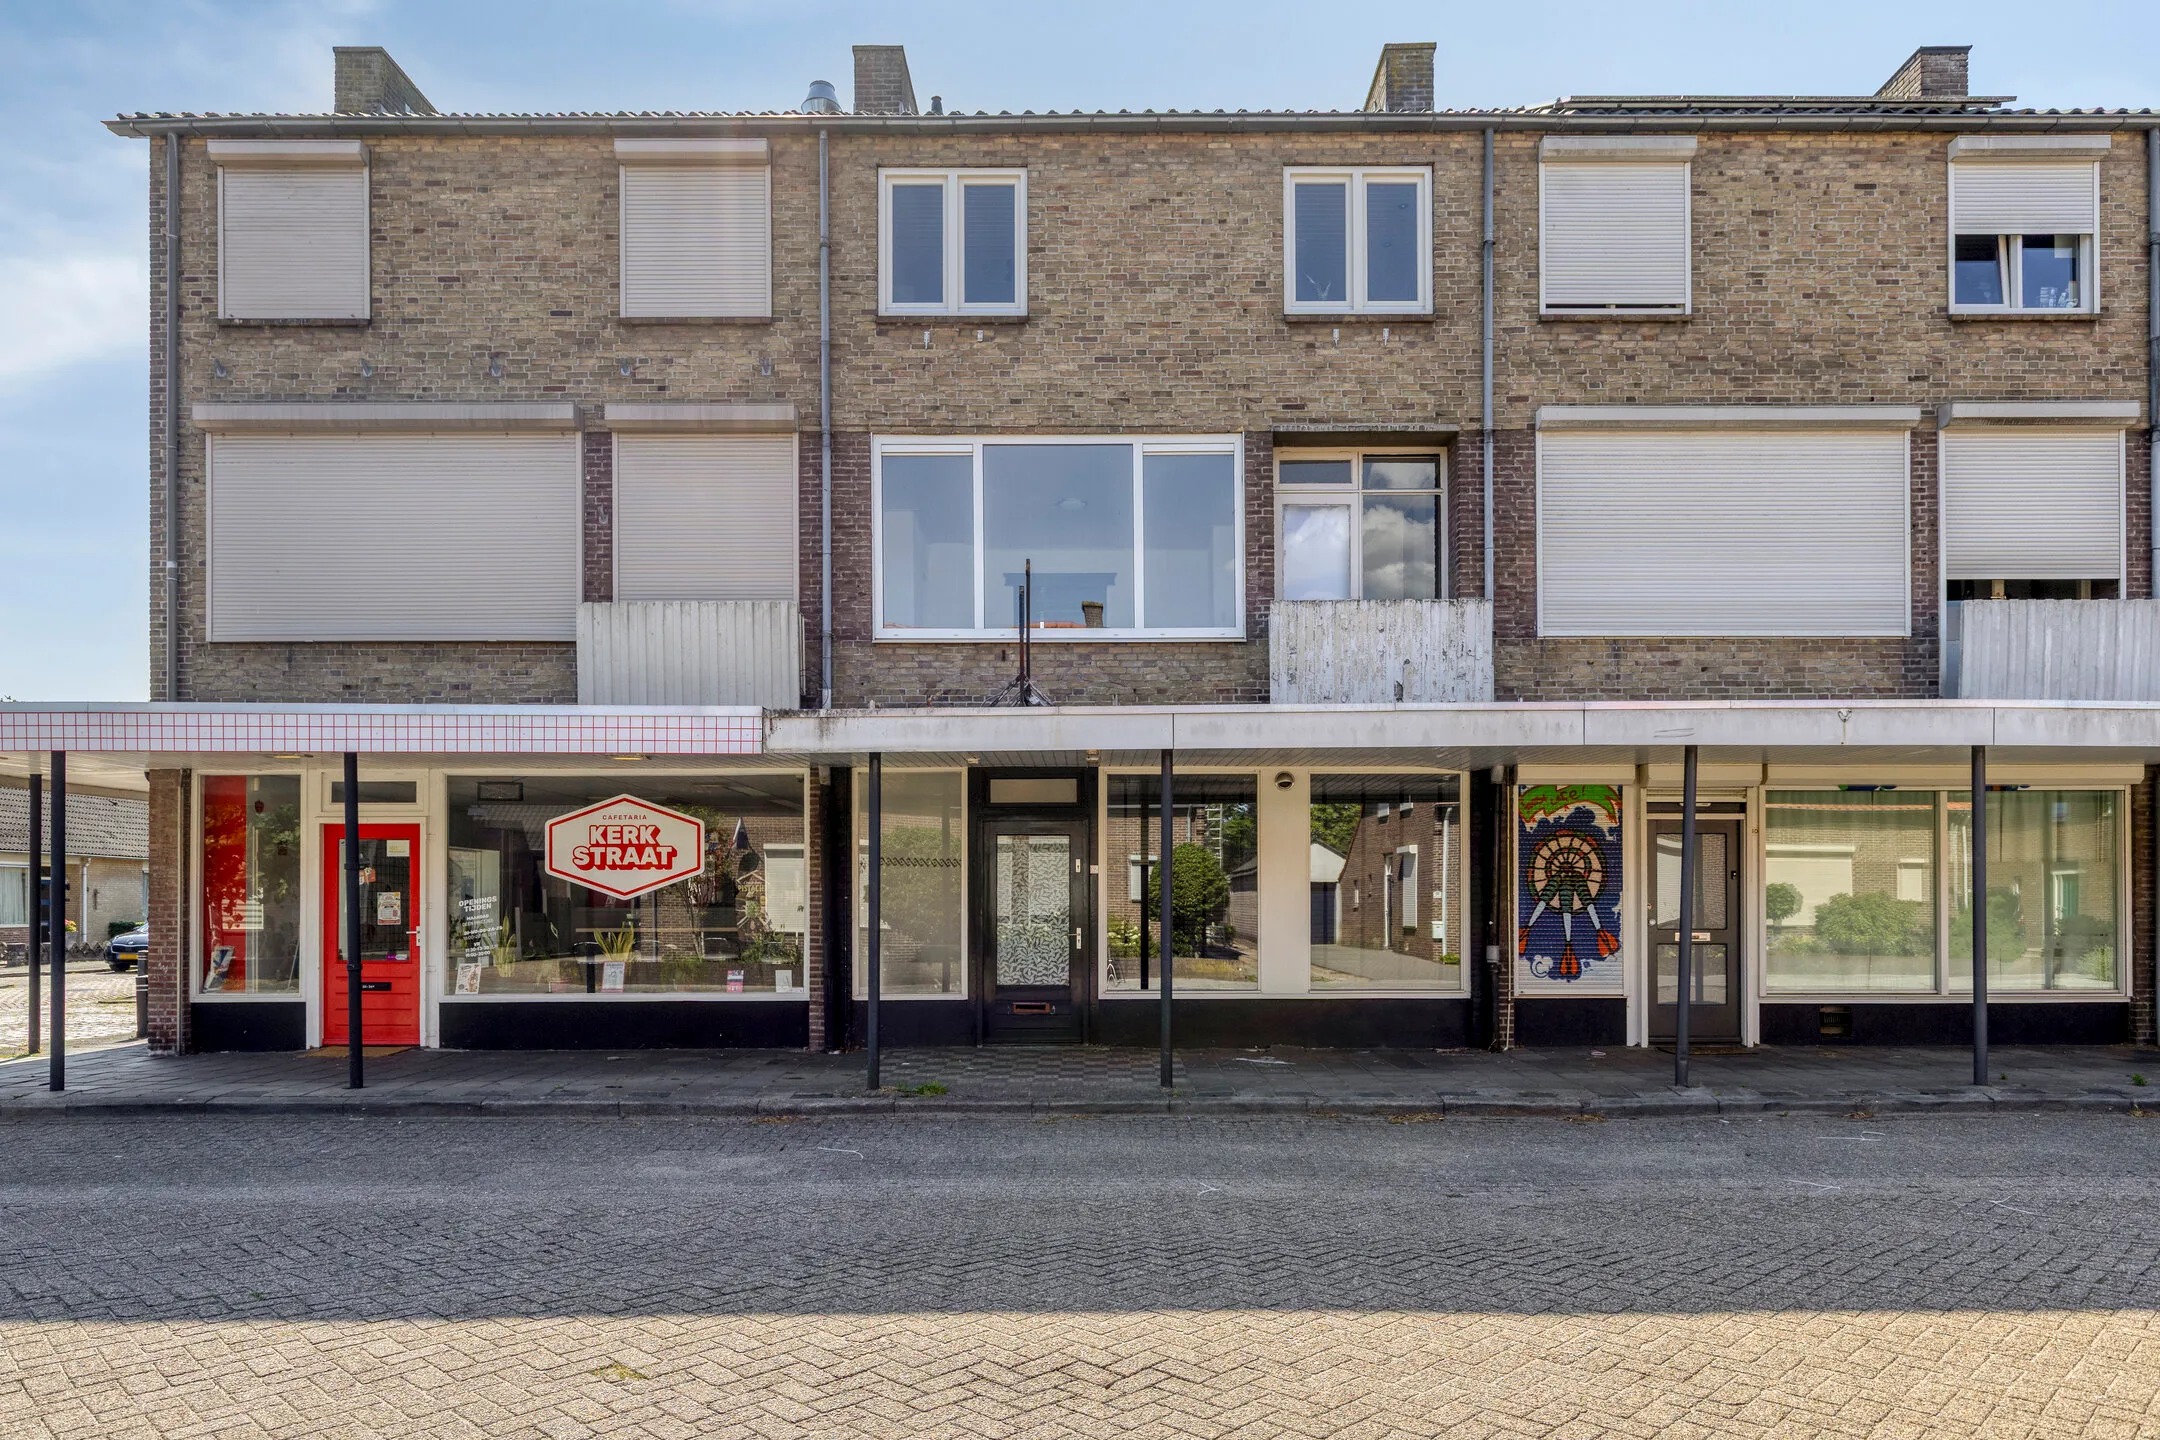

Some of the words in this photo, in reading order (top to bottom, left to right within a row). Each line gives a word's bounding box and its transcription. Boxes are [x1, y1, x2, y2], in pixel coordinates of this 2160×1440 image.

[589, 824, 660, 845] KERK
[572, 846, 677, 869] STRAAT
[458, 896, 497, 907] OPENINGS
[463, 903, 492, 912] TIJDEN
